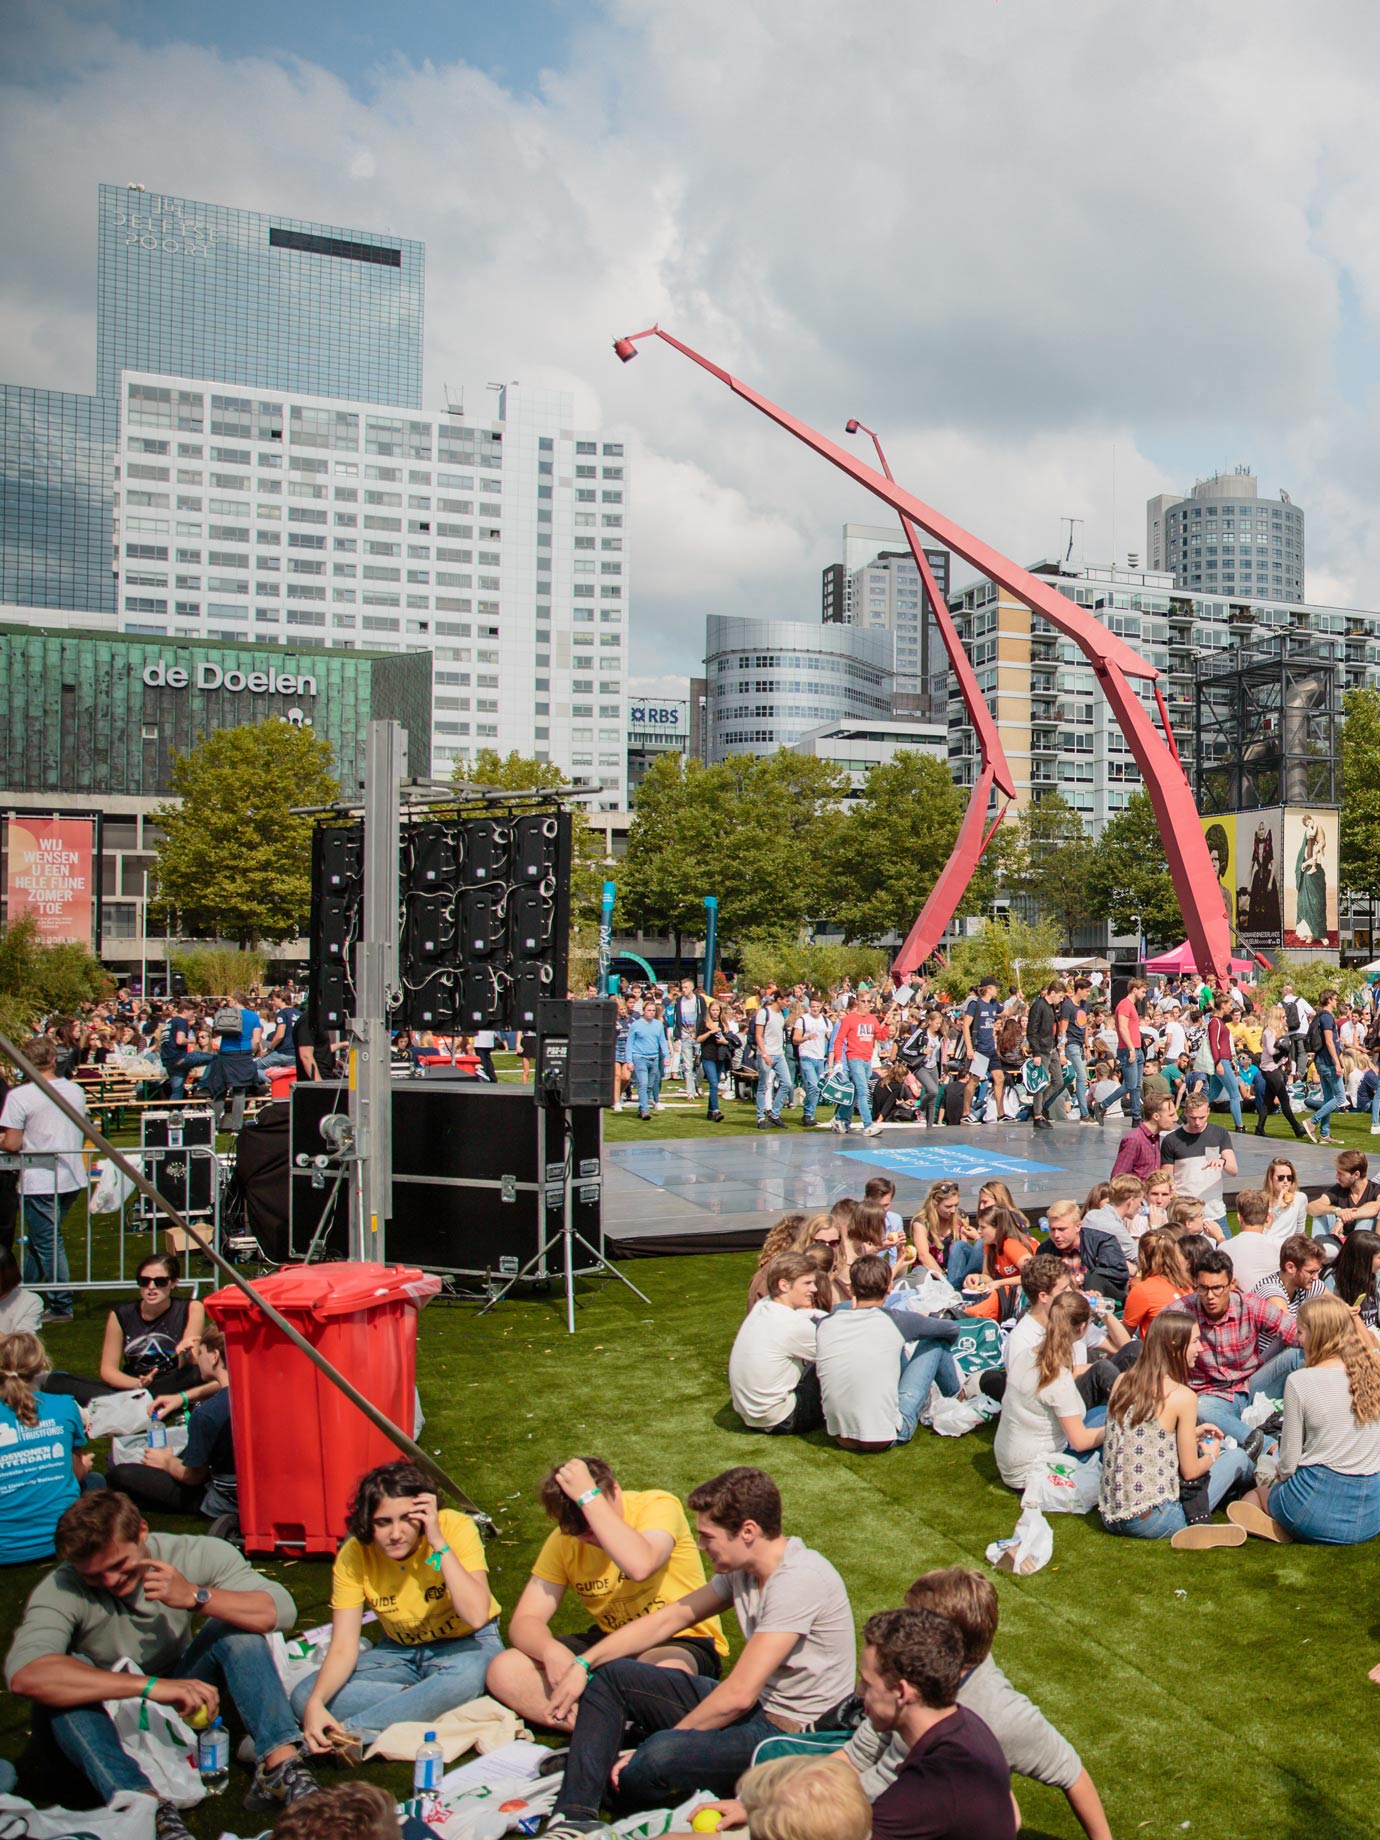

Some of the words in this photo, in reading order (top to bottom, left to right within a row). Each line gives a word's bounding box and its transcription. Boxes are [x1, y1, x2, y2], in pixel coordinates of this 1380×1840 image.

[126, 232, 209, 259] POORT
[143, 659, 189, 688] de
[197, 662, 317, 696] Doelen
[648, 708, 679, 724] RBS
[40, 838, 63, 851] WIJ
[24, 851, 79, 864] WENSEN
[32, 864, 41, 876] U
[45, 864, 70, 876] EEN
[15, 876, 47, 889] HELE
[51, 877, 85, 890] FIJNE
[27, 889, 73, 902] ZOMER
[37, 902, 63, 915] TOE
[371, 1594, 398, 1608] UIDE
